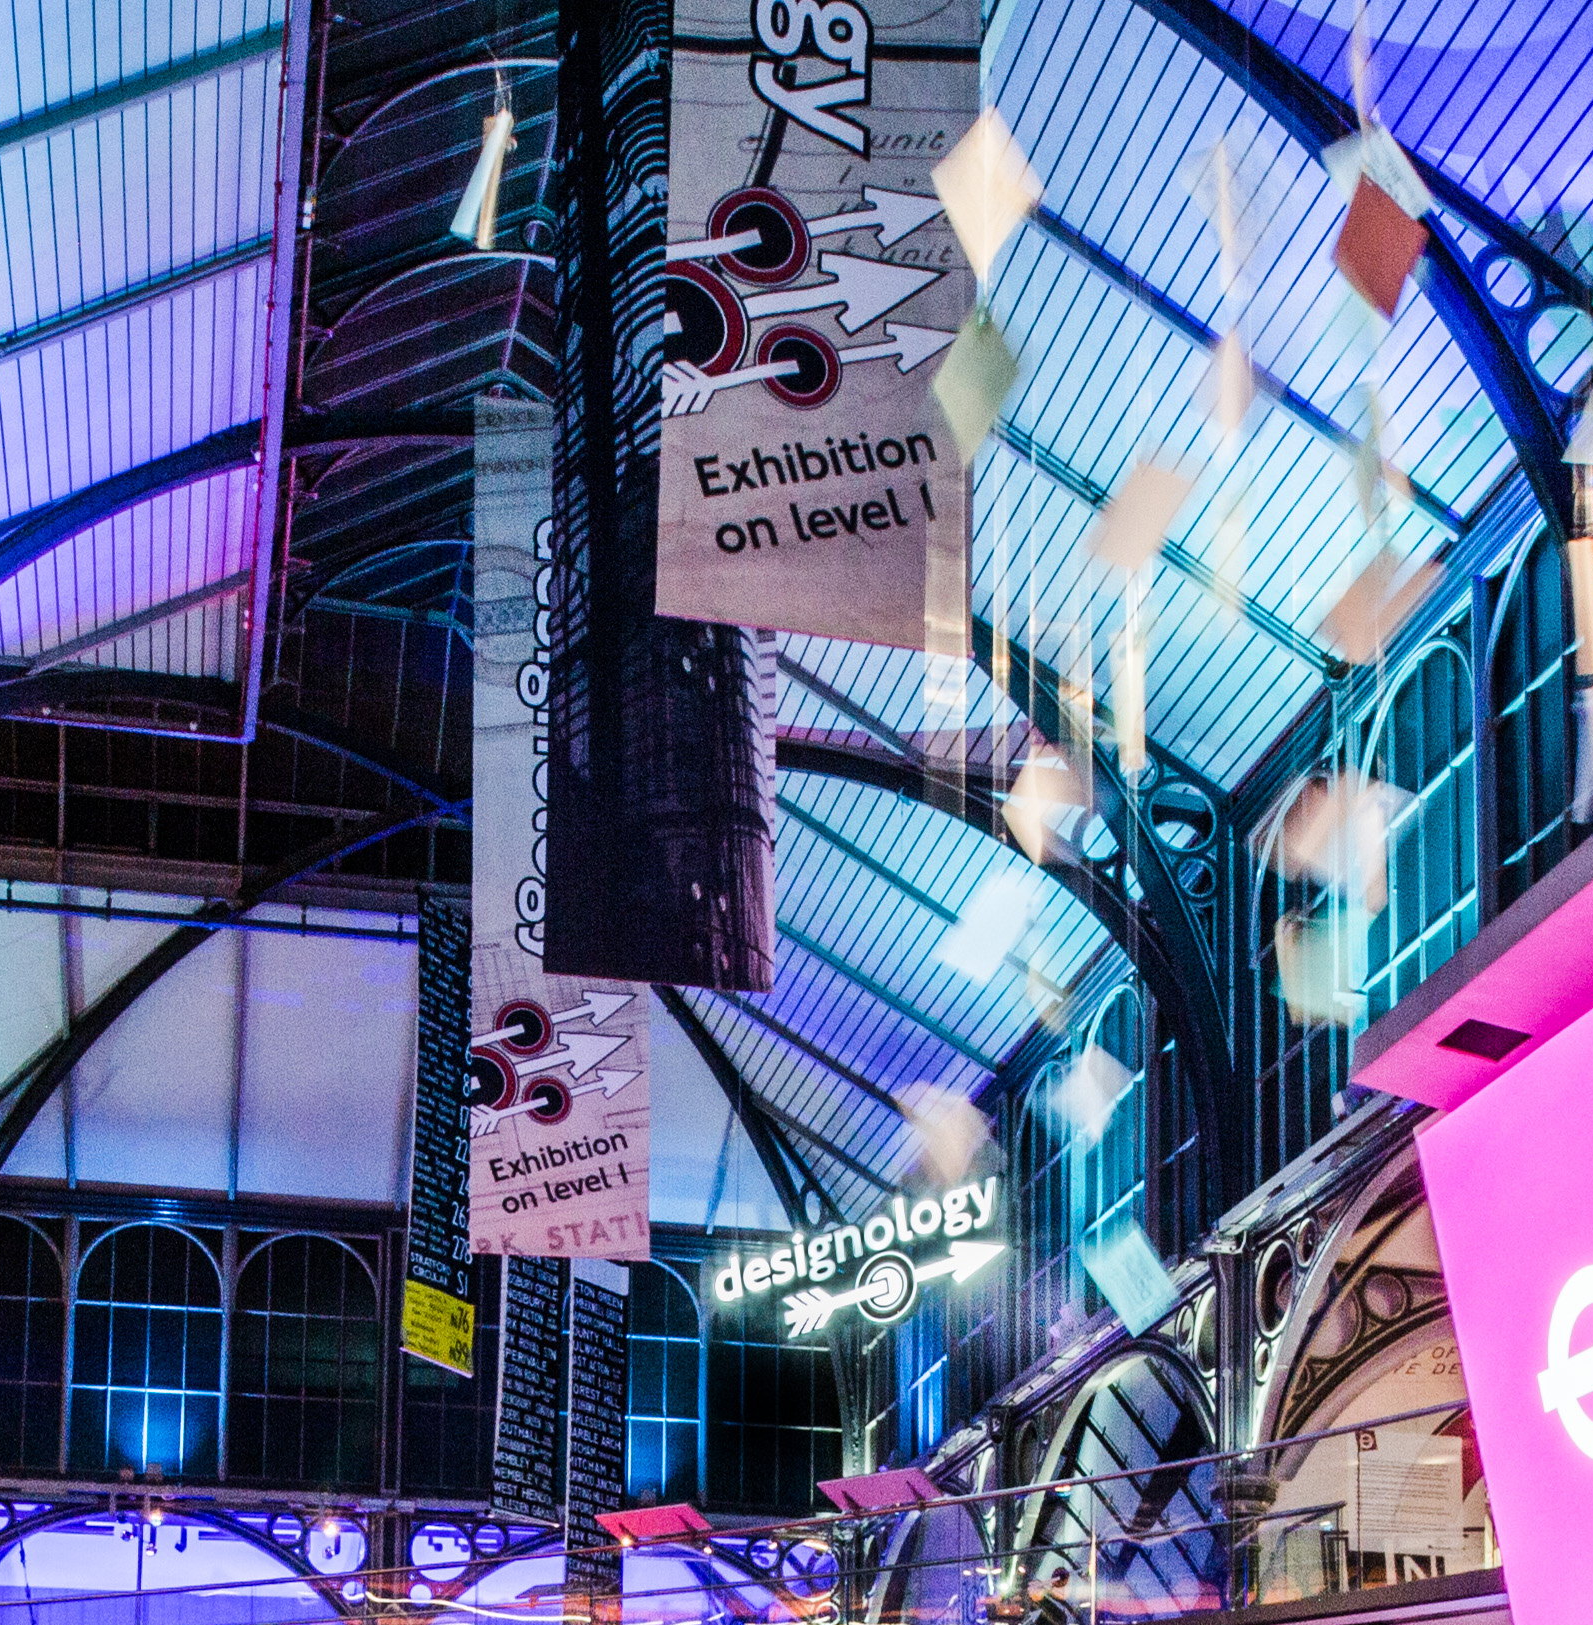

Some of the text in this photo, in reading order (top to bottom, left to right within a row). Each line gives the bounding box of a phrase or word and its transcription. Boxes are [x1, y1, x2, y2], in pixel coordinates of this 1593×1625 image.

[693, 431, 938, 498] Exhibition
[714, 516, 780, 554] on
[789, 487, 908, 542] level
[488, 1132, 629, 1183] Exhibition
[501, 1191, 539, 1214] on
[543, 1166, 613, 1203] level
[713, 1176, 998, 1303] designology
